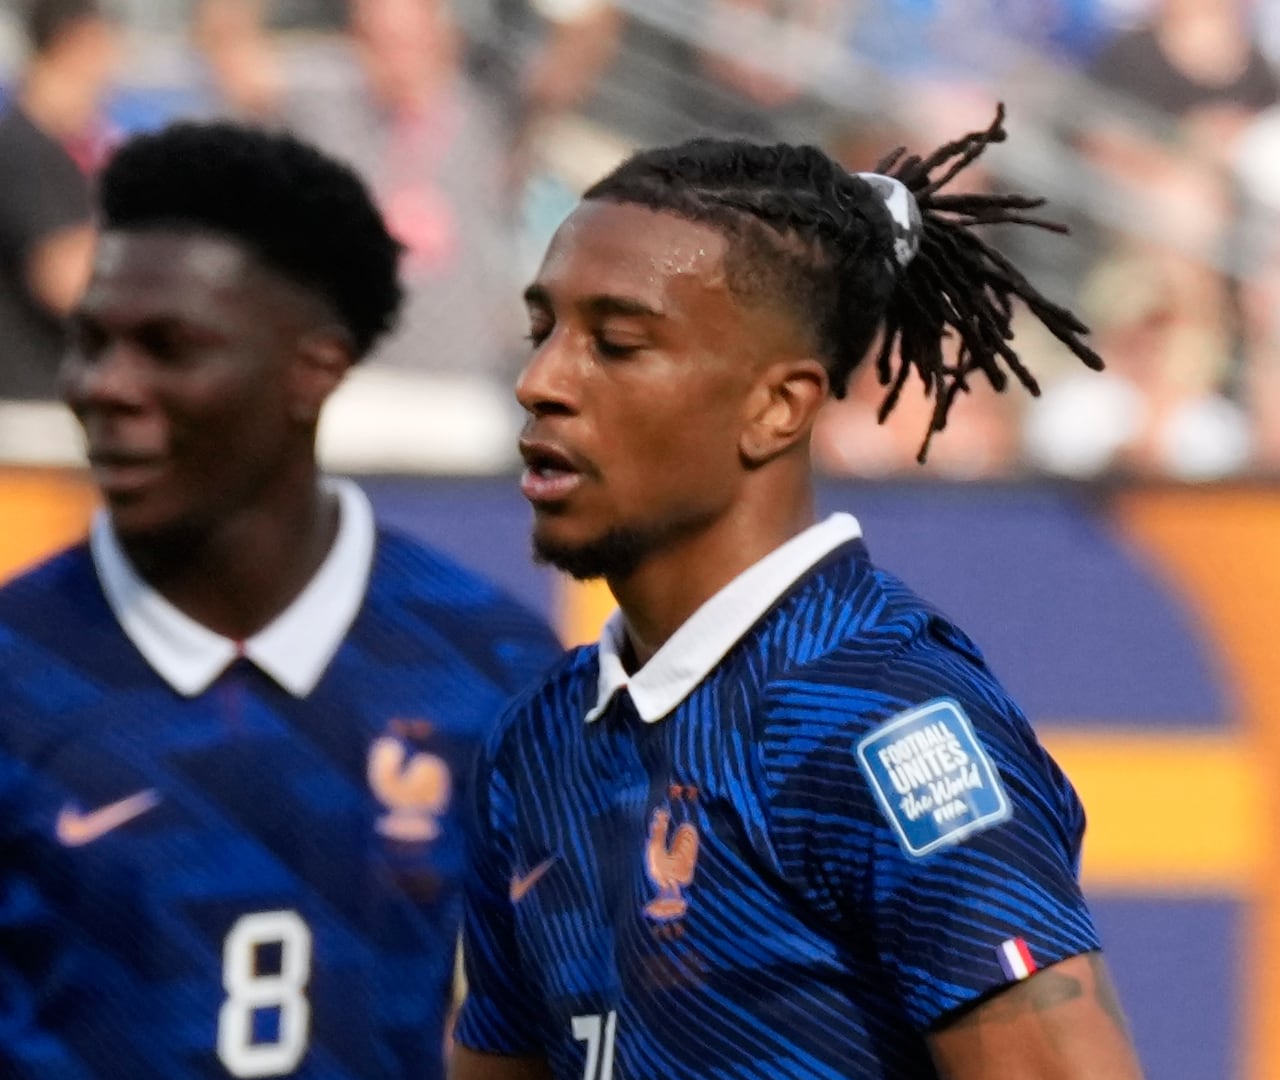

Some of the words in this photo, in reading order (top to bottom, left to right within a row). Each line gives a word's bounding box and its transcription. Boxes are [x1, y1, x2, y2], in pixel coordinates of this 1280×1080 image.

[878, 720, 956, 770] FOOTBALL
[889, 740, 969, 795] UNITES
[899, 791, 934, 822] the
[928, 763, 984, 805] World
[933, 799, 968, 824] FIFA
[216, 910, 313, 1080] 8
